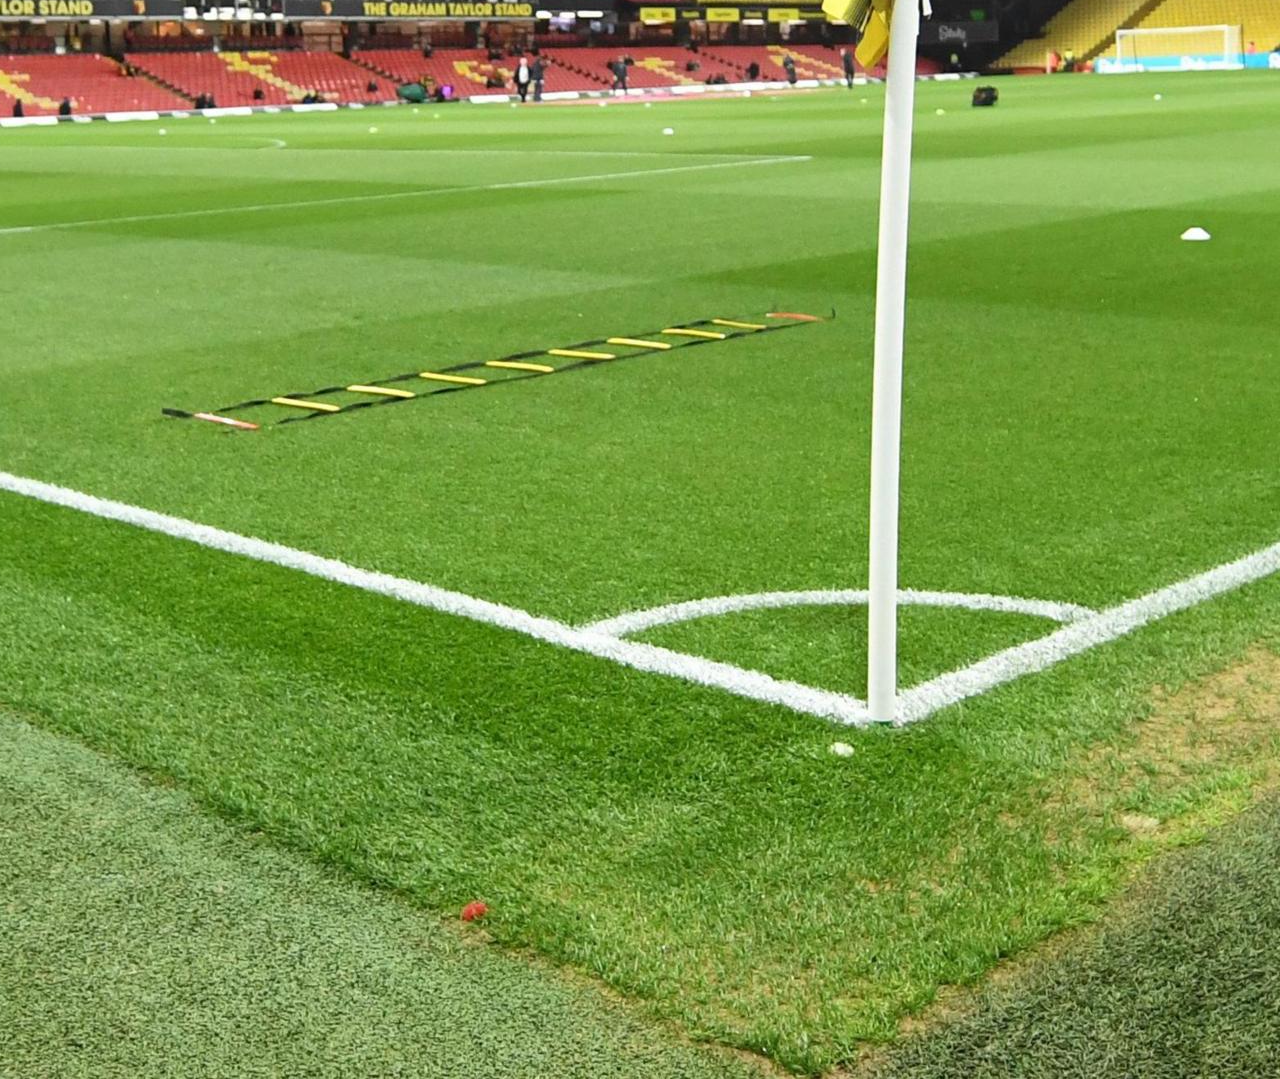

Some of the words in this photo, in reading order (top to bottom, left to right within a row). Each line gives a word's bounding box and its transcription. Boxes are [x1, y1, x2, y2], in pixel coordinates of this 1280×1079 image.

[39, 0, 94, 16] STAND
[363, 1, 387, 16] THE
[389, 1, 446, 16] GRAHAM
[449, 1, 493, 16] TAYLOR
[495, 1, 533, 17] STAND
